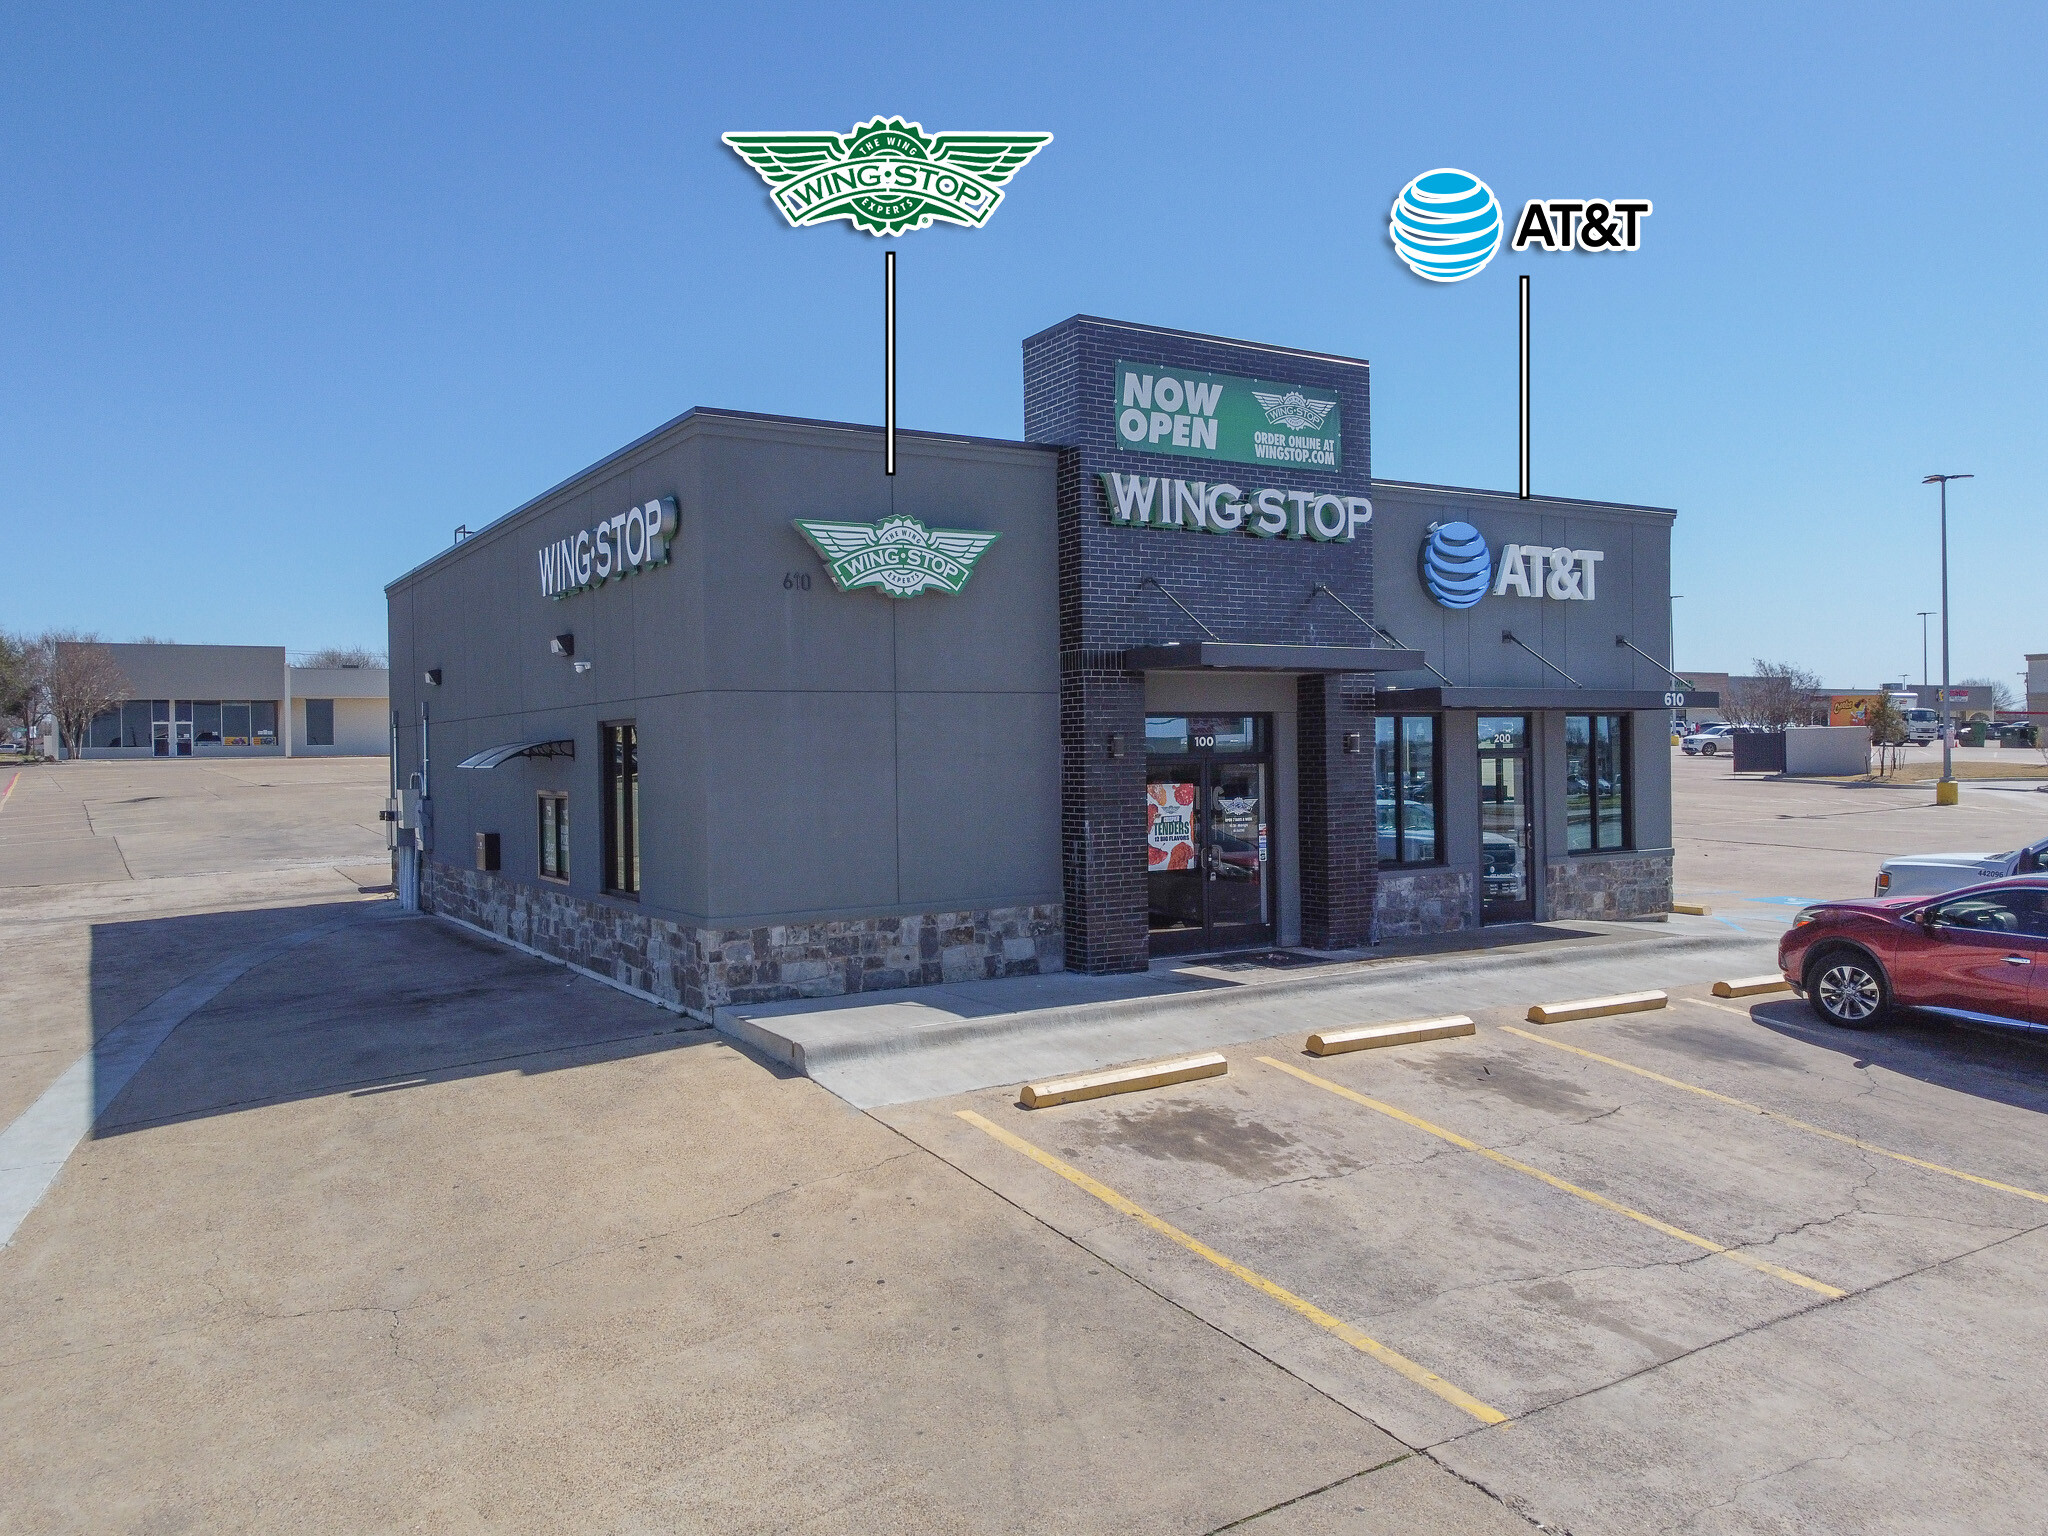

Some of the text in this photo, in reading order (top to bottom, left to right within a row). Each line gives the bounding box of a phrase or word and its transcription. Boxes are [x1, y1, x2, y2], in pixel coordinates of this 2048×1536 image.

[1122, 372, 1223, 416] NOW
[1119, 408, 1219, 451] OPEN
[1254, 430, 1335, 452] ORDER ONLINE AT
[1254, 443, 1336, 466] WINGSTOP.COM
[885, 529, 922, 544] THE WING
[887, 571, 920, 584] EXPERTS
[1492, 543, 1605, 601] AT&T
[782, 572, 812, 591] 610
[1664, 692, 1685, 707] 610
[1194, 736, 1214, 747] 100
[1494, 733, 1511, 744] 200
[1154, 821, 1190, 836] TENDERS
